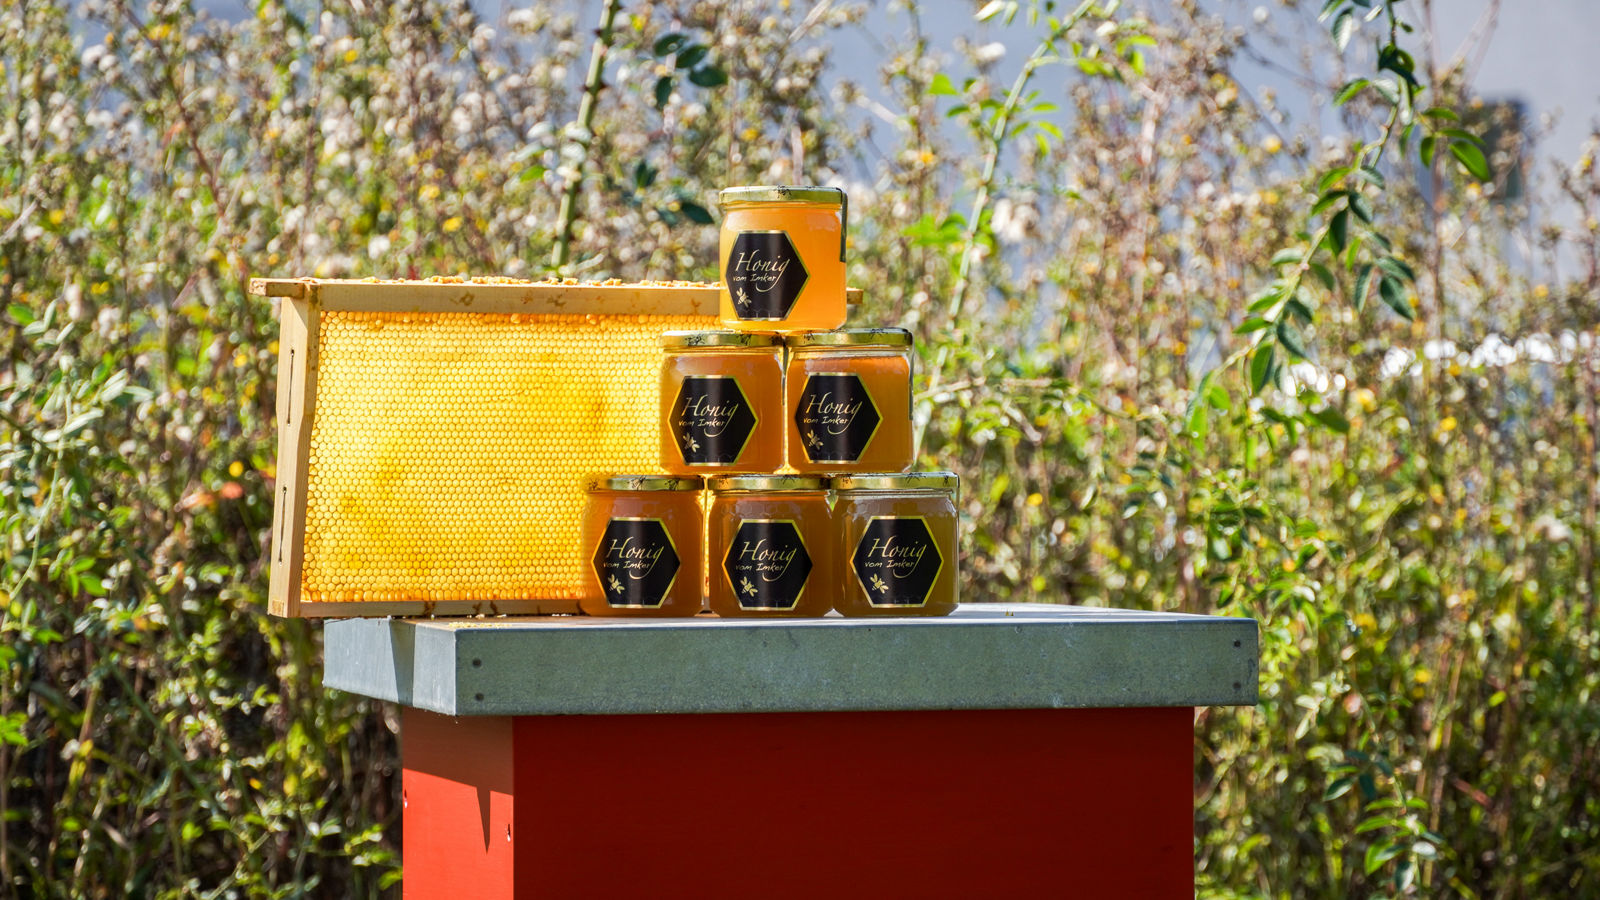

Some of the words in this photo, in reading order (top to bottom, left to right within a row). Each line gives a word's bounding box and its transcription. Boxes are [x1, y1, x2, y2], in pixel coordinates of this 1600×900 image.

[735, 249, 790, 292] Honig
[751, 273, 777, 282] Imker
[681, 394, 739, 437] Honig
[697, 419, 725, 427] Imker
[803, 417, 819, 425] vom
[822, 416, 849, 425] Imker
[806, 392, 863, 434] Honig
[606, 536, 665, 579] Honig
[623, 561, 651, 570] Imker
[739, 539, 797, 581] Honig
[755, 563, 783, 572] Imker
[864, 561, 882, 569] vom
[886, 560, 914, 569] Imker
[868, 536, 927, 578] Honig
